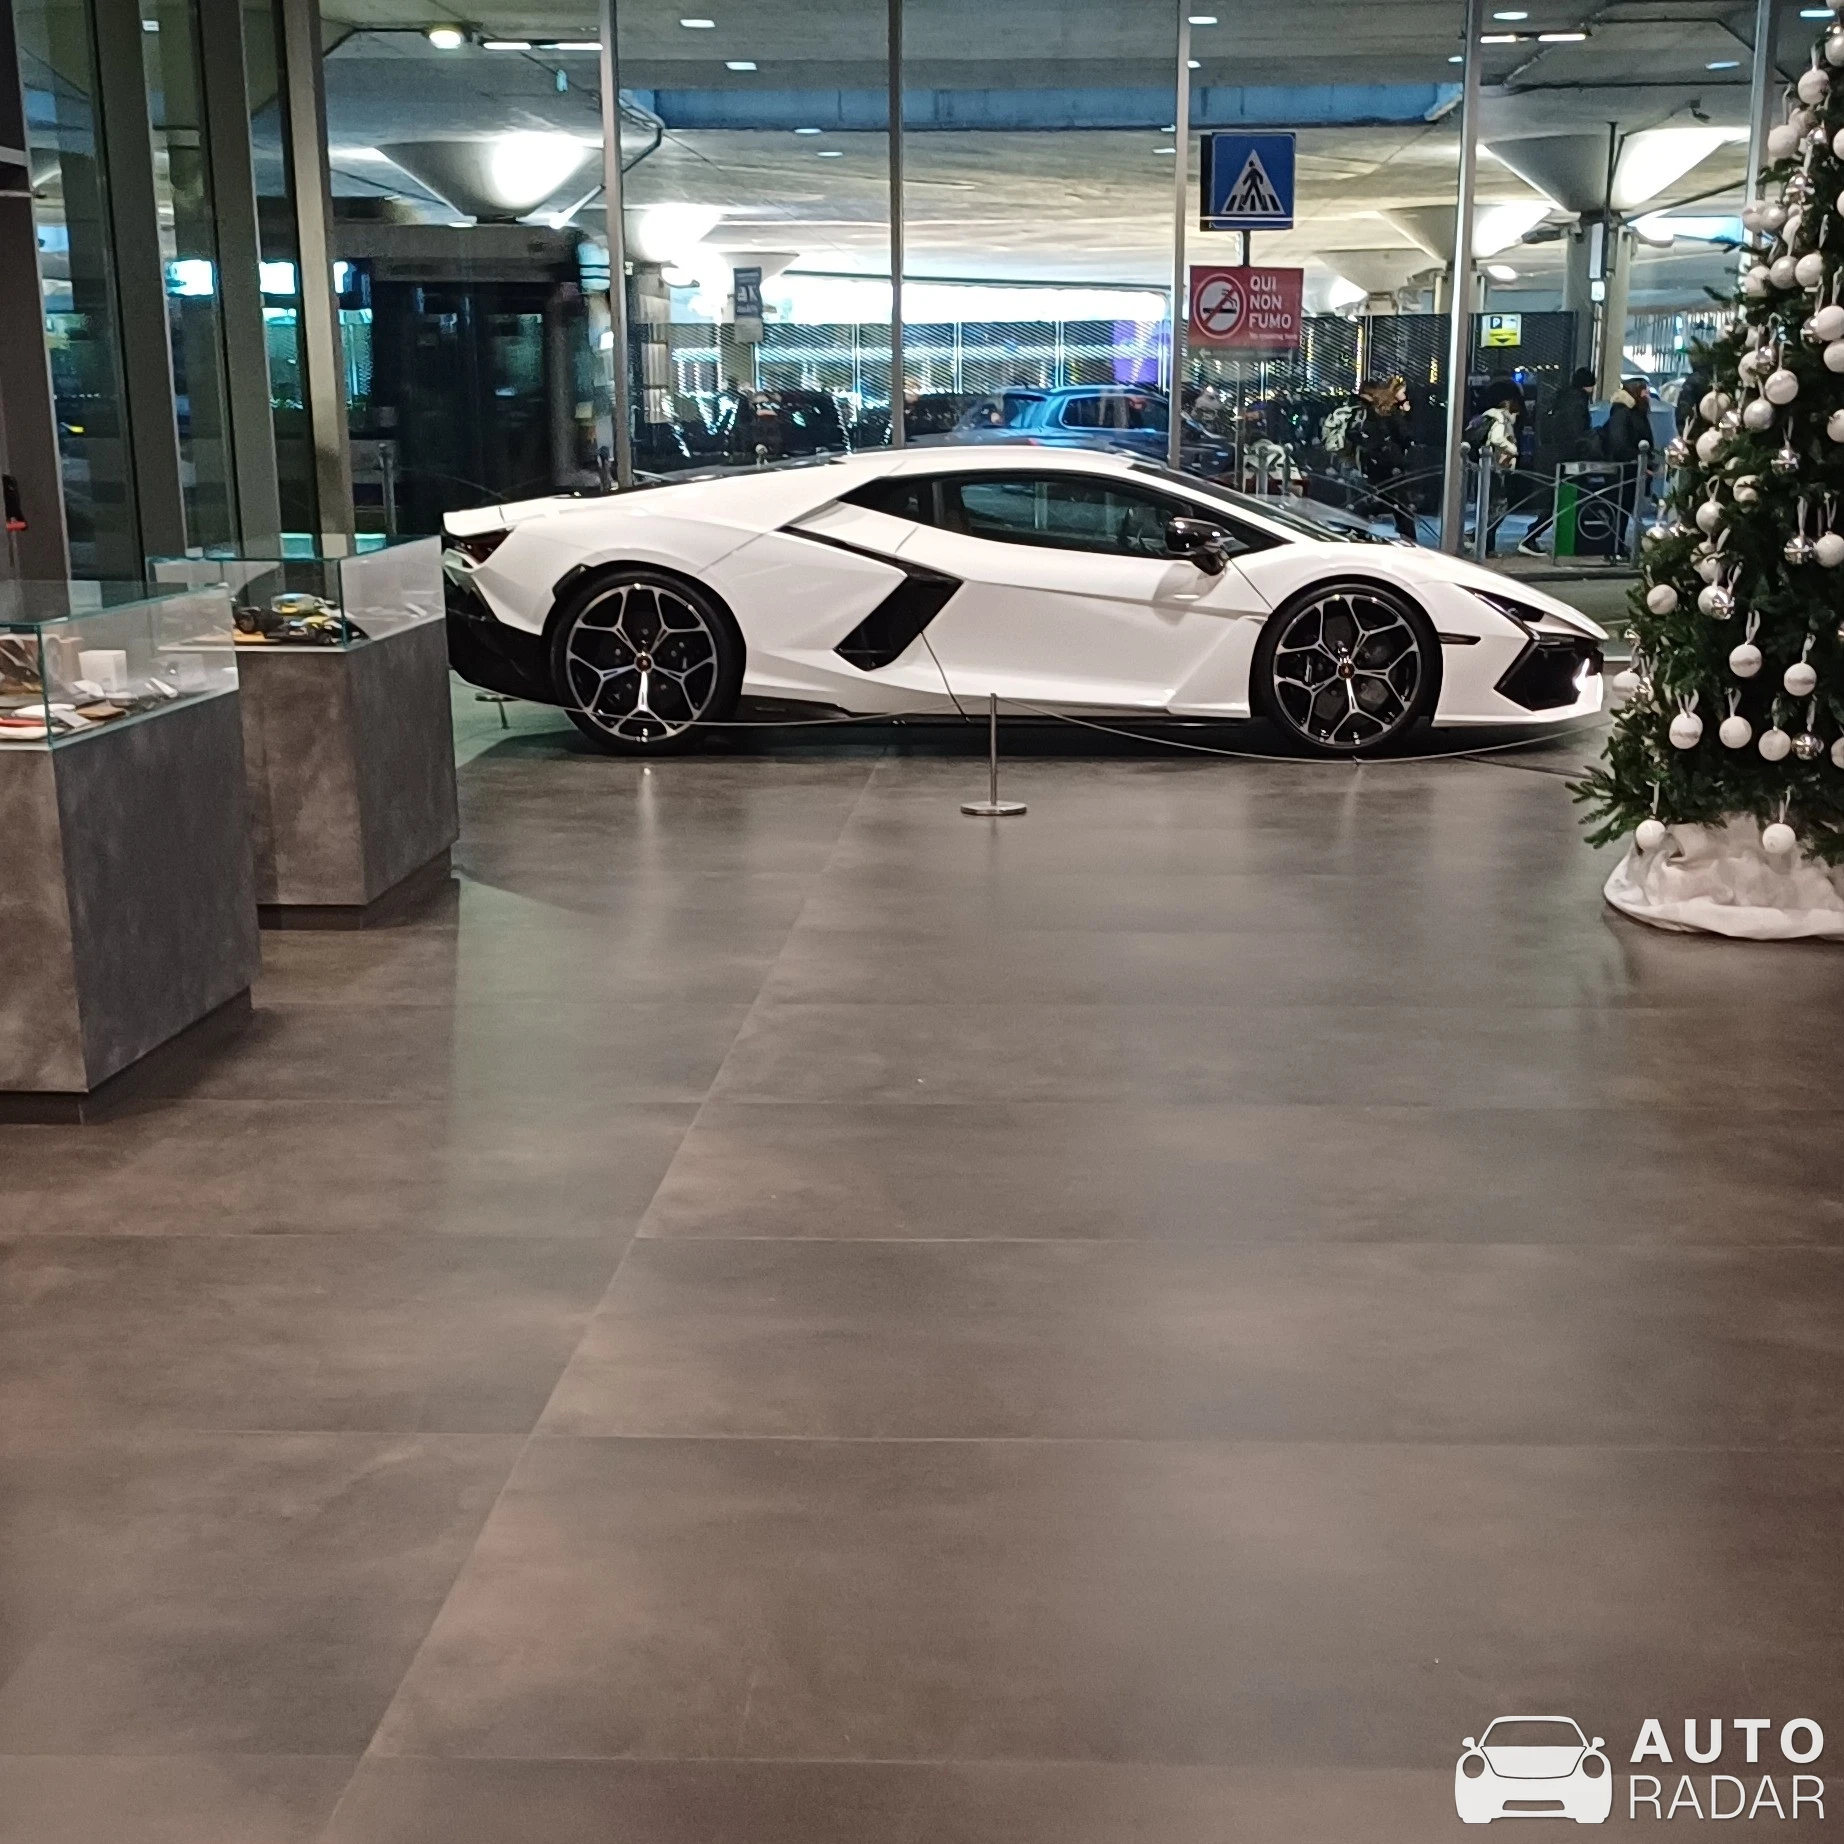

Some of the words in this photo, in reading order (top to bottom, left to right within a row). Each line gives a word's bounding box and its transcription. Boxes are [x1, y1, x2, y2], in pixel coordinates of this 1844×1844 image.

[1250, 275, 1277, 292] QUI
[1249, 295, 1283, 310] NON
[1248, 313, 1292, 329] FUMO
